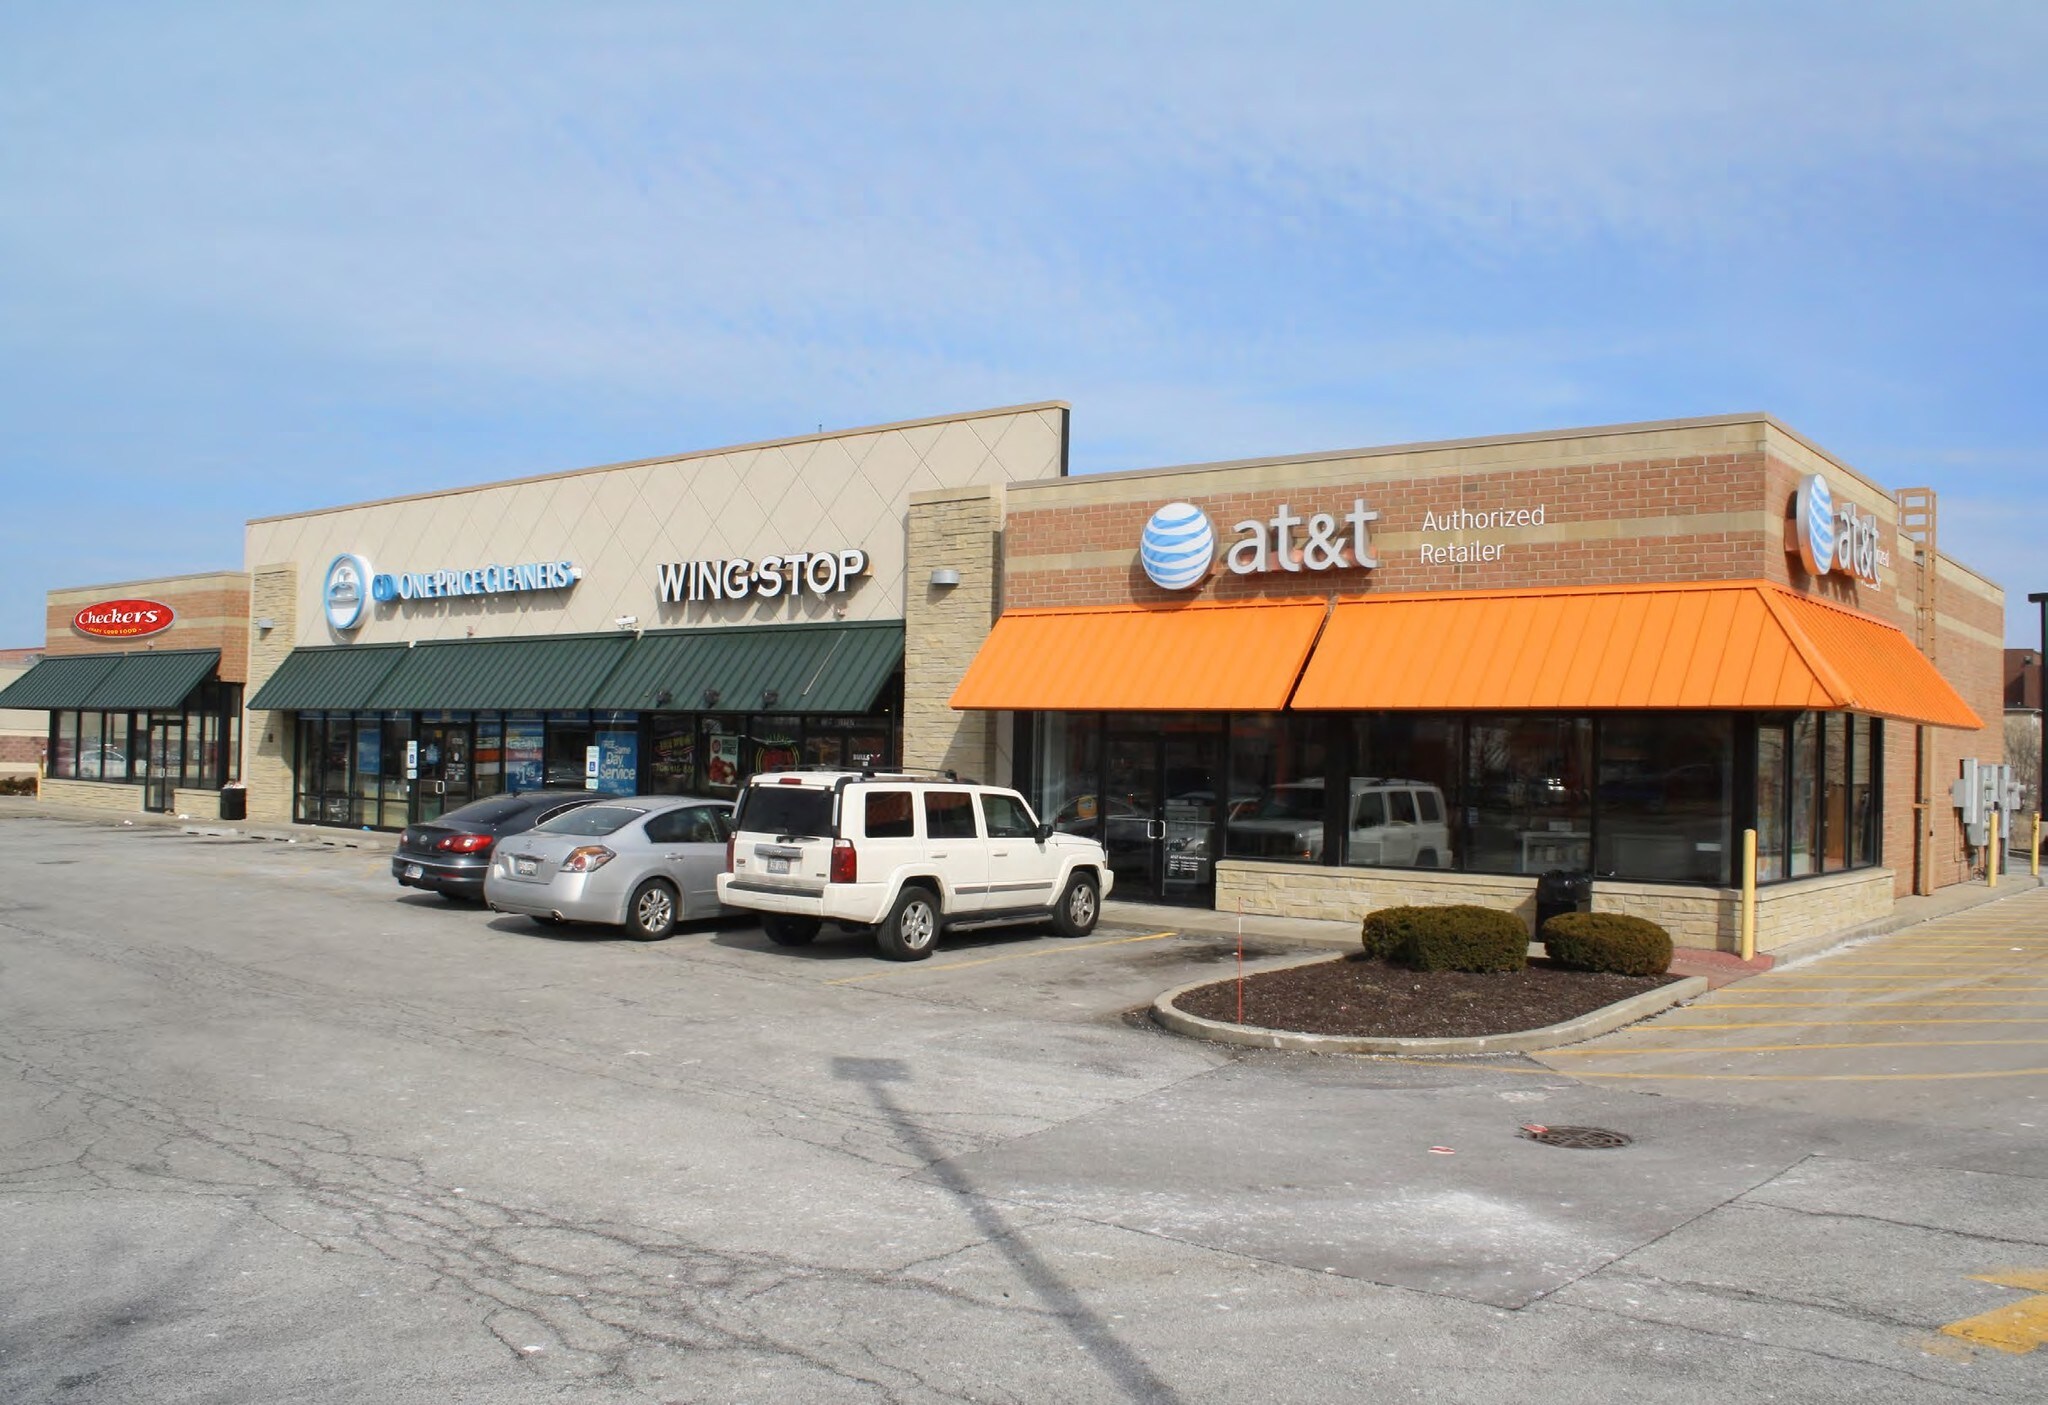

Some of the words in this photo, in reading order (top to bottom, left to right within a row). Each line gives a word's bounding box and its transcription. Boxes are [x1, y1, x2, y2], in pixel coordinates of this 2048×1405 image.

[1422, 503, 1545, 531] Authorized
[1228, 498, 1379, 575] at&t
[1420, 540, 1505, 564] Retailer
[400, 573, 435, 599] ONE
[434, 568, 483, 596] PRICE
[483, 561, 573, 592] CLEANERS
[78, 608, 158, 625] Checkers
[600, 763, 636, 780] Service
